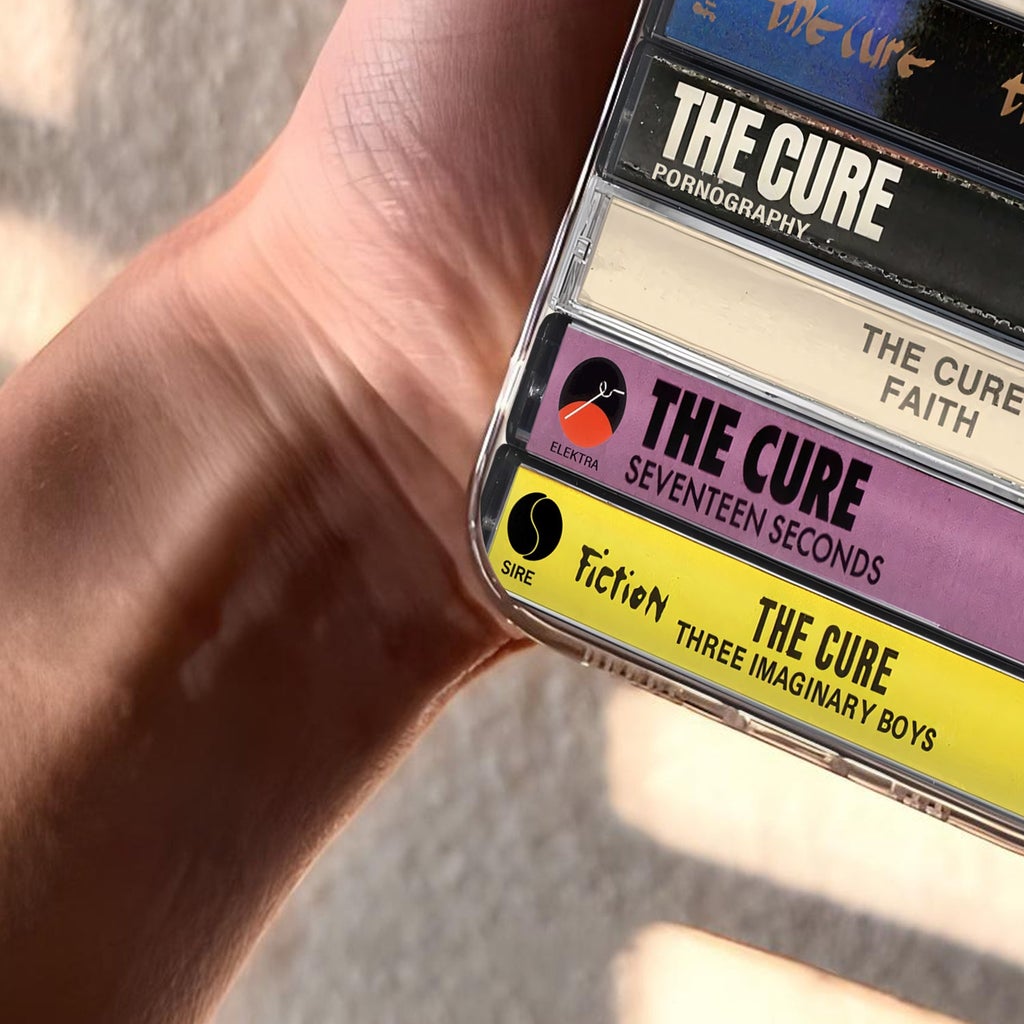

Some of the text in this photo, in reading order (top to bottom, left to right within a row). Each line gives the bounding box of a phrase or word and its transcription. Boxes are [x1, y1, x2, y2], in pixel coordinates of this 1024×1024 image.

[841, 15, 936, 78] cure
[662, 81, 903, 242] THE CURE
[651, 162, 810, 239] PORNOGRAPHY
[862, 323, 927, 374] THE
[879, 375, 980, 439] FAITH
[550, 441, 600, 472] ELEKTRA
[641, 378, 873, 531] THE CURE
[624, 454, 886, 585] SEVENTEEN SECONDS
[501, 560, 536, 586] SIRE
[752, 596, 899, 697] THE CURE
[675, 619, 937, 752] THREE IMAGINARY BOYS
